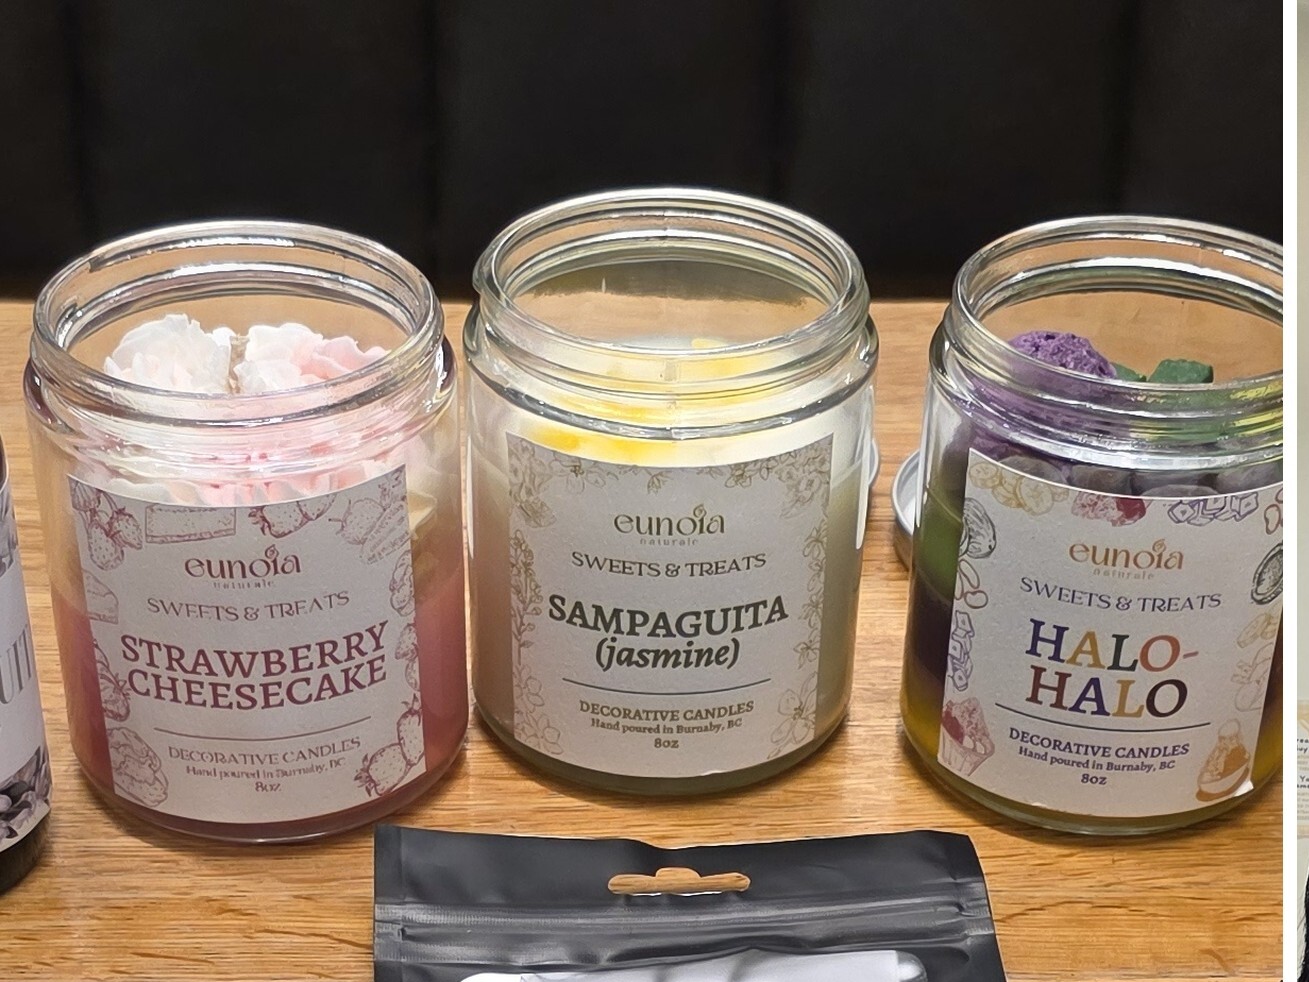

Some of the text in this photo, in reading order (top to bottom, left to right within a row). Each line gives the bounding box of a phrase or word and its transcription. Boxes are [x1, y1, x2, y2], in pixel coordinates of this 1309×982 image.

[614, 503, 725, 536] eunoia
[185, 544, 301, 578] eunoia
[572, 552, 767, 577] SWEETS & TREATS
[1069, 538, 1184, 570] eunoia
[147, 590, 349, 621] SWEETS & TREATS
[1020, 576, 1222, 612] SWEETS & TREATS
[549, 594, 789, 638] SAMPAGUITA
[120, 620, 389, 679] STRAWBERRY
[595, 636, 740, 672] (jasmine)
[1025, 618, 1199, 672] HALO-
[128, 654, 386, 710] CHEESECAKE
[1025, 664, 1188, 718] HALO
[580, 700, 755, 722] DECORATIVE CANDLES
[591, 718, 743, 735] Hand poured in Burnaby, BC
[168, 736, 361, 766] DECORATIVE CANDLES
[653, 738, 680, 749] 8oz
[1009, 727, 1190, 759] DECORATIVE CANDLES
[1019, 746, 1176, 771] Hand poured in BC
[1080, 773, 1107, 785] 8oz
